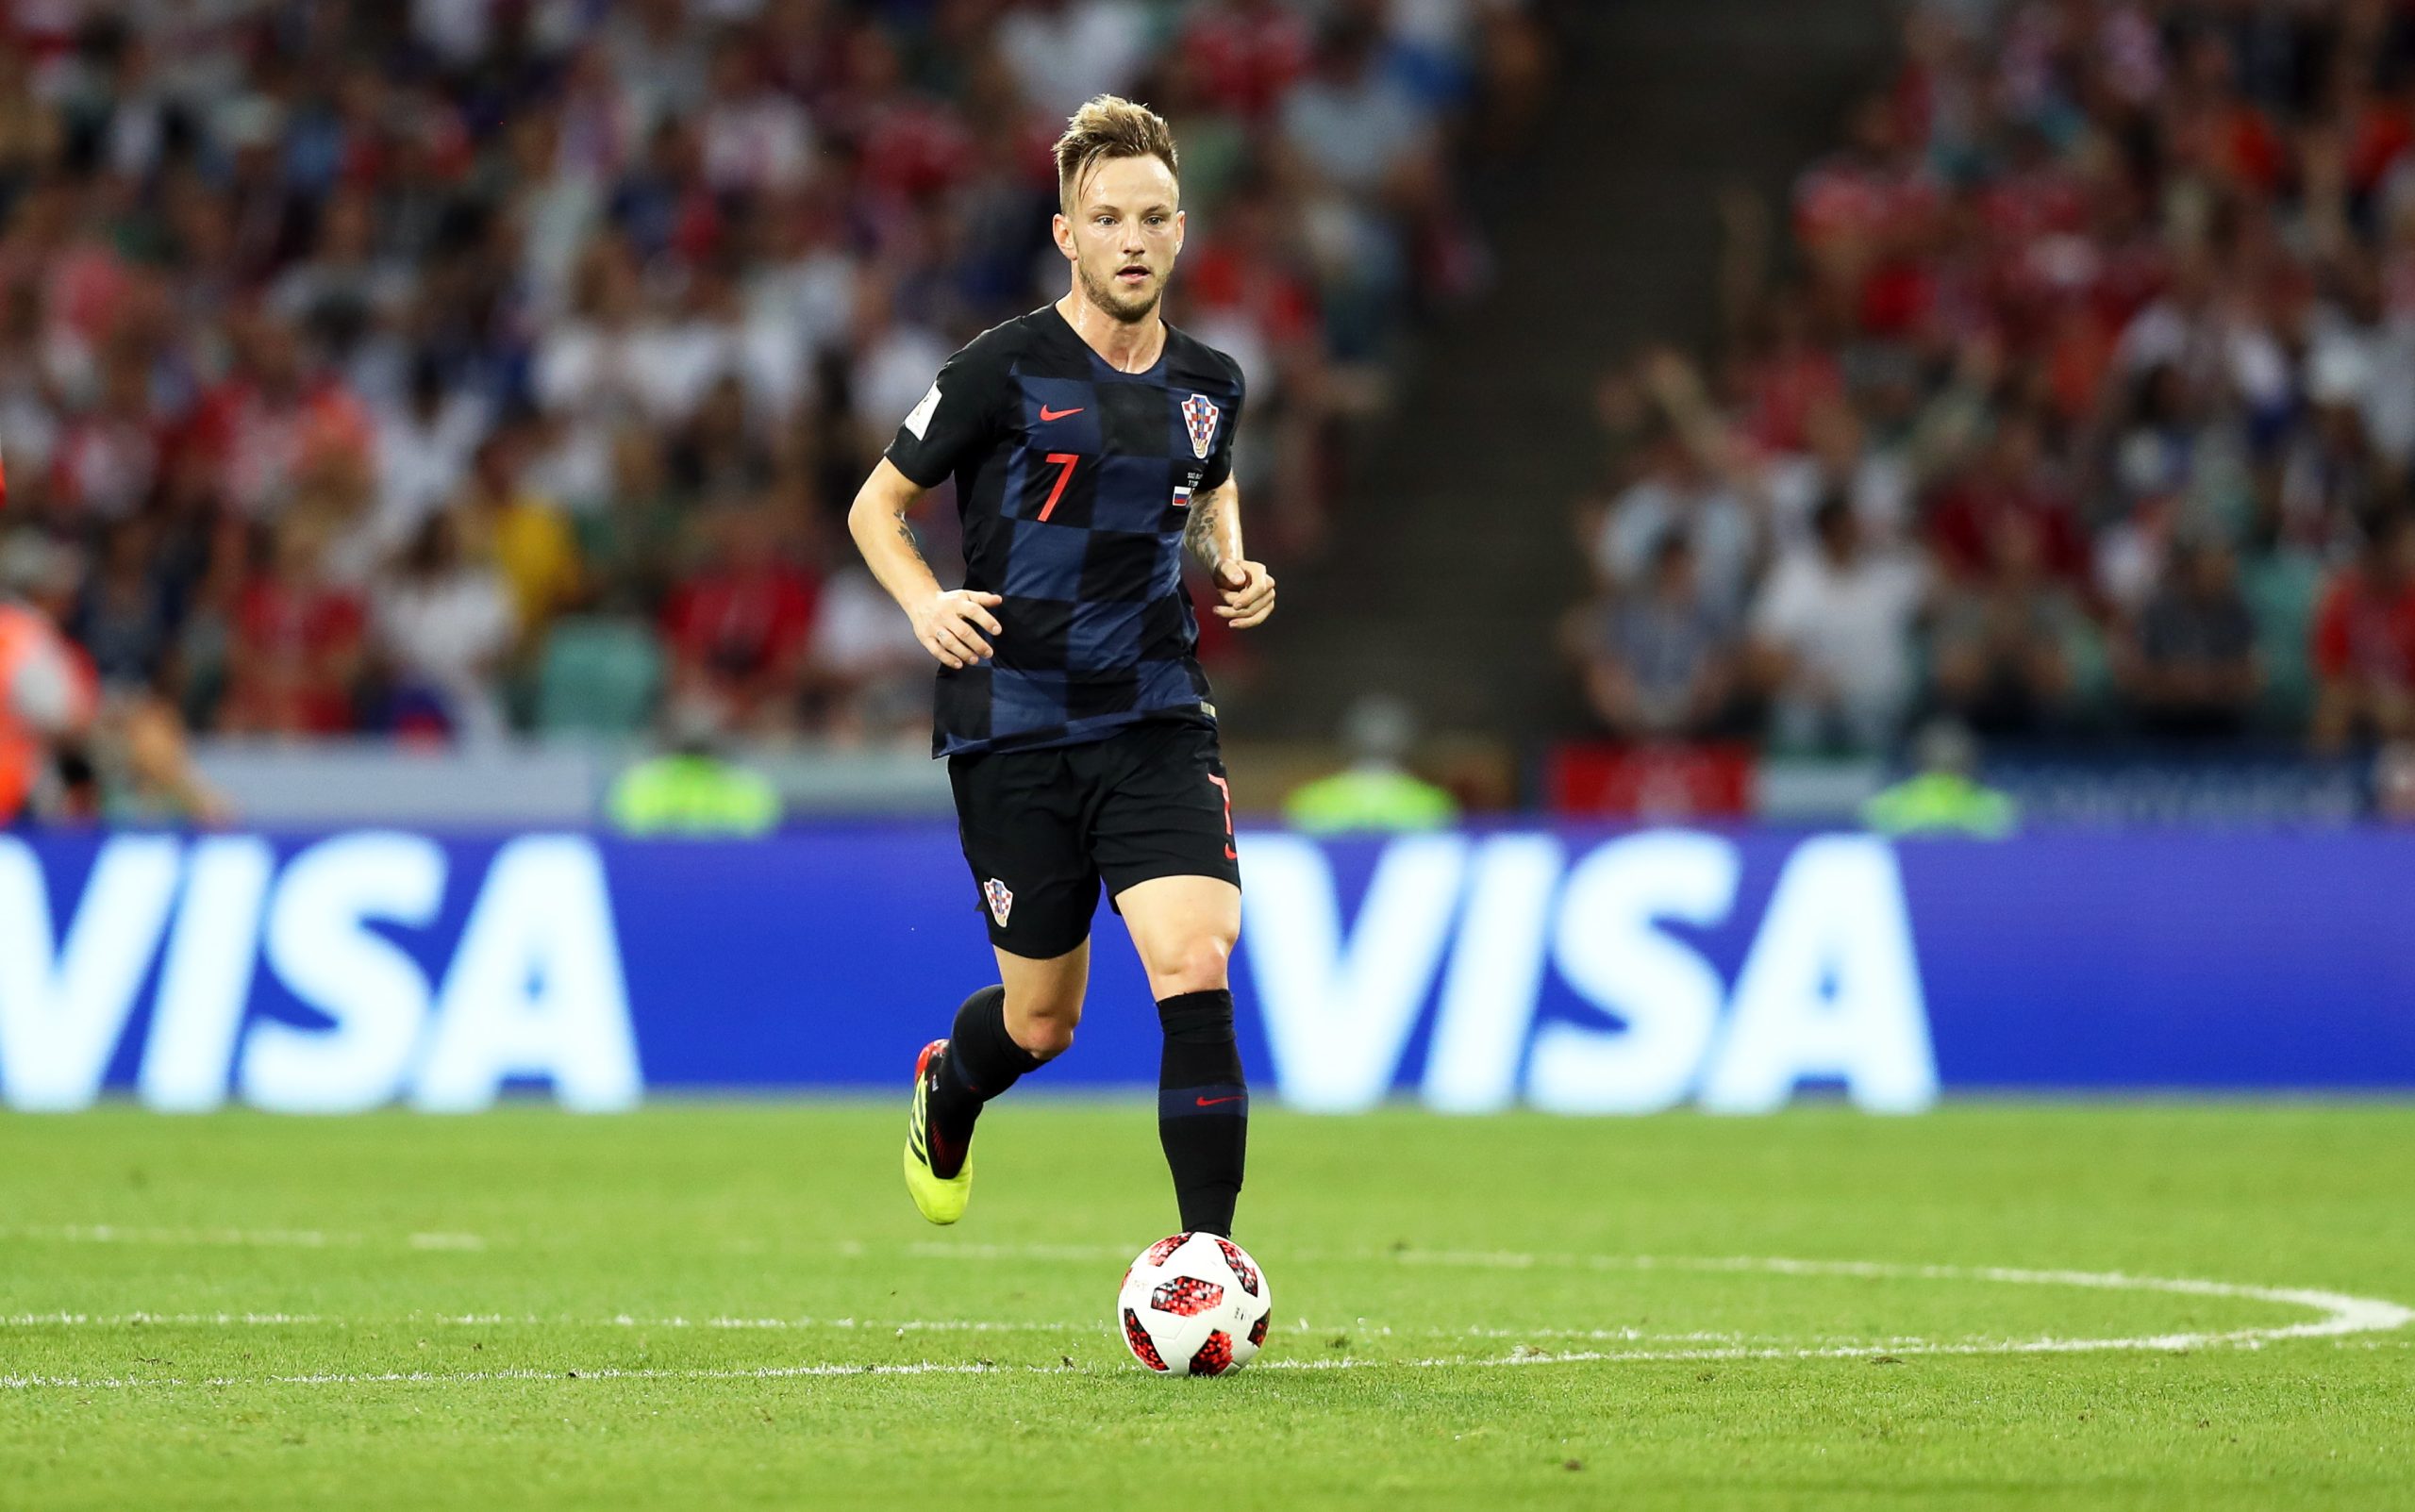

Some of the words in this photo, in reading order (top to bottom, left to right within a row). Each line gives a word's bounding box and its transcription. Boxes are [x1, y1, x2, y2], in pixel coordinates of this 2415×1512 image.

[1038, 454, 1079, 522] 7
[0, 832, 643, 1111] VISA
[1236, 829, 1939, 1112] VISA
